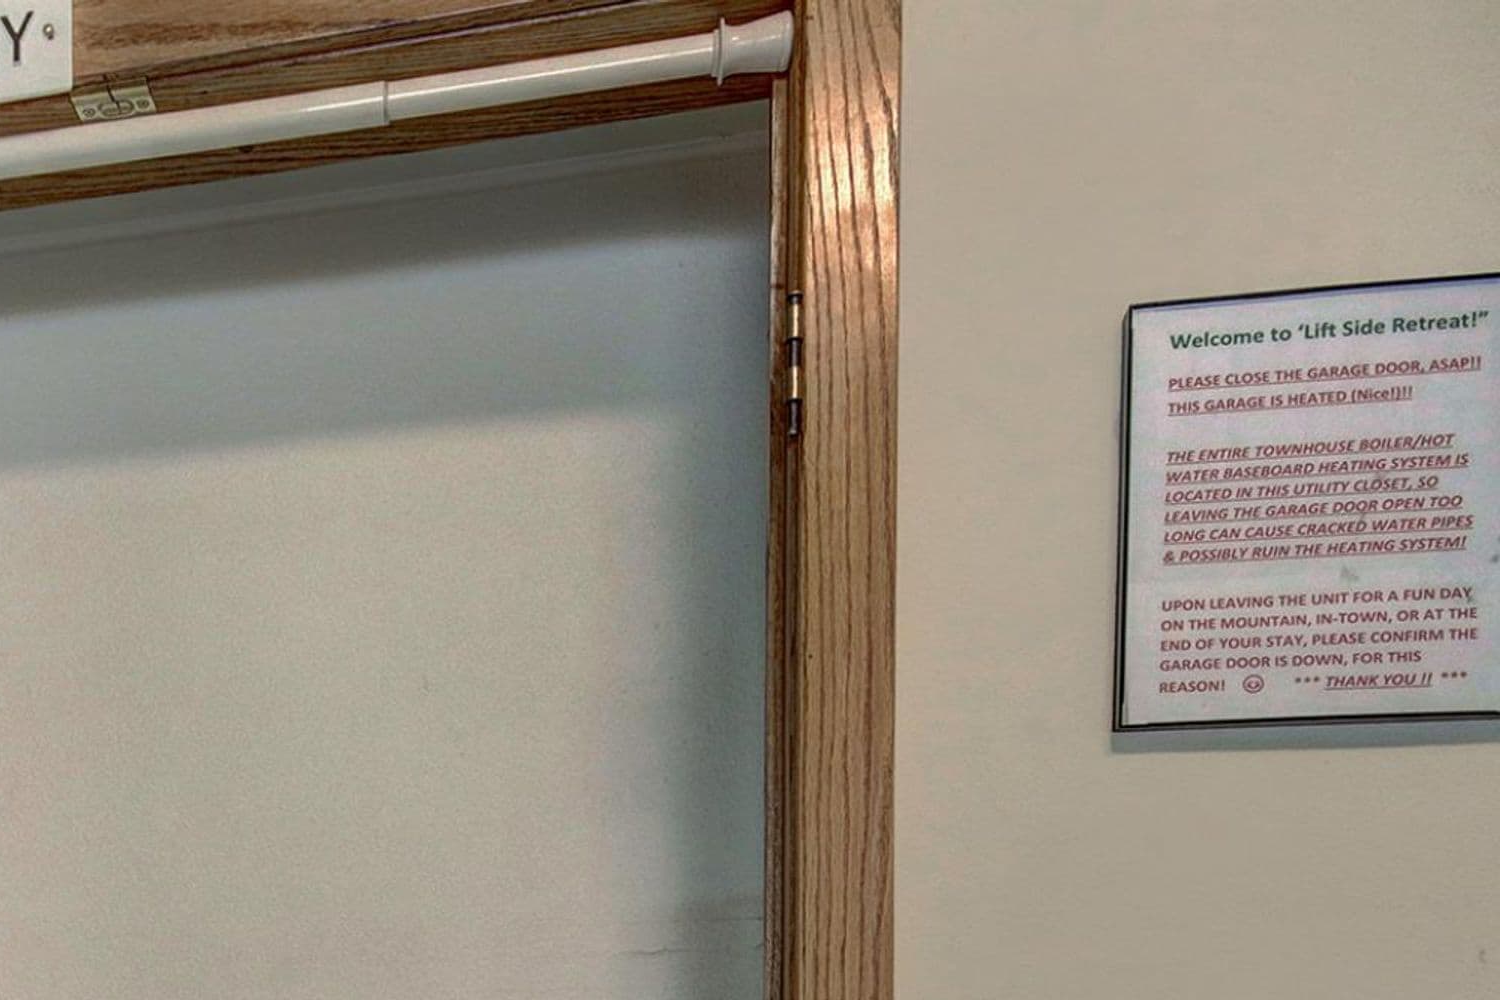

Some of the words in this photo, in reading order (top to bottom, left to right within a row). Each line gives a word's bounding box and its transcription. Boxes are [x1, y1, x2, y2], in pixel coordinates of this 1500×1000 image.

[1170, 331, 1264, 349] Welcome
[1271, 328, 1292, 342] to
[1343, 319, 1386, 336] Side
[1168, 374, 1220, 390] PLEASE
[1225, 371, 1270, 386] CLOSE
[1275, 368, 1302, 382] THE
[1307, 364, 1371, 380] GARAGE
[1375, 360, 1425, 376] DOOR,
[1429, 355, 1482, 372] ASAP!!
[1168, 402, 1200, 415] THIS
[1204, 396, 1266, 411] GARAGE
[1271, 394, 1283, 407] IS
[1287, 390, 1347, 406] HEATED
[1166, 450, 1197, 464] THE
[1198, 447, 1250, 462] ENTIRE
[1254, 440, 1355, 458] TOWNHOUSE
[1359, 433, 1455, 451] BOILER/HOT
[1165, 468, 1219, 484] WATER
[1223, 462, 1314, 480] BASEBOARD
[1318, 457, 1387, 474] HEATING
[1390, 454, 1452, 470] SYSTEM
[1455, 453, 1470, 466] IS
[1165, 488, 1232, 504] LOCATED
[1236, 487, 1252, 499] IN
[1257, 484, 1290, 498] THIS
[1293, 480, 1349, 496] UTILITY
[1353, 477, 1414, 492] CLOSET,
[1417, 475, 1439, 489] SO
[1164, 508, 1229, 524] LEAVING
[1233, 506, 1261, 519] THE
[1265, 502, 1329, 518] GARAGE
[1332, 500, 1378, 514] DOOR
[1382, 496, 1425, 511] OPEN
[1429, 495, 1463, 509] TOO
[1164, 529, 1206, 543] LONG
[1209, 527, 1241, 541] CAN
[1244, 524, 1295, 539] CAUSE
[1297, 520, 1367, 537] CRACKED
[1372, 517, 1427, 533] WATER
[1430, 514, 1475, 530] PIPES
[1163, 551, 1174, 563] &
[1179, 547, 1248, 563] POSSIBLY
[1252, 545, 1290, 559] RUIN
[1294, 543, 1324, 557] THE
[1327, 539, 1396, 555] HEATING
[1400, 535, 1467, 552] SYSTEM!
[1161, 599, 1205, 612] UPON
[1209, 595, 1274, 610] LEAVING
[1278, 594, 1307, 607] THE
[1311, 592, 1350, 606] UNIT
[1352, 590, 1384, 603] FOR
[1386, 590, 1399, 601] A
[1403, 588, 1435, 601] FUN
[1161, 620, 1184, 632] ON
[1188, 618, 1217, 630] THE
[1220, 614, 1312, 630] MOUNTAIN,
[1316, 611, 1392, 625] IN-TOWN,
[1396, 609, 1419, 622] OR
[1423, 608, 1444, 620] AT
[1448, 607, 1478, 619] THE
[1160, 640, 1191, 652] END
[1195, 638, 1215, 650] OF
[1219, 637, 1262, 649] YOUR
[1266, 635, 1308, 648] STAY,
[1312, 632, 1366, 646] PLEASE
[1370, 629, 1444, 644] CONFIRM
[1448, 628, 1478, 640] THE
[1159, 658, 1221, 672] GARAGE
[1226, 656, 1270, 669] DOOR
[1274, 655, 1288, 667] IS
[1292, 652, 1348, 666] DOWN,
[1352, 652, 1383, 664] FOR
[1387, 651, 1422, 663] THIS
[1159, 680, 1226, 694] REASON!
[1325, 674, 1378, 688] THANK
[1383, 673, 1416, 687] YOU
